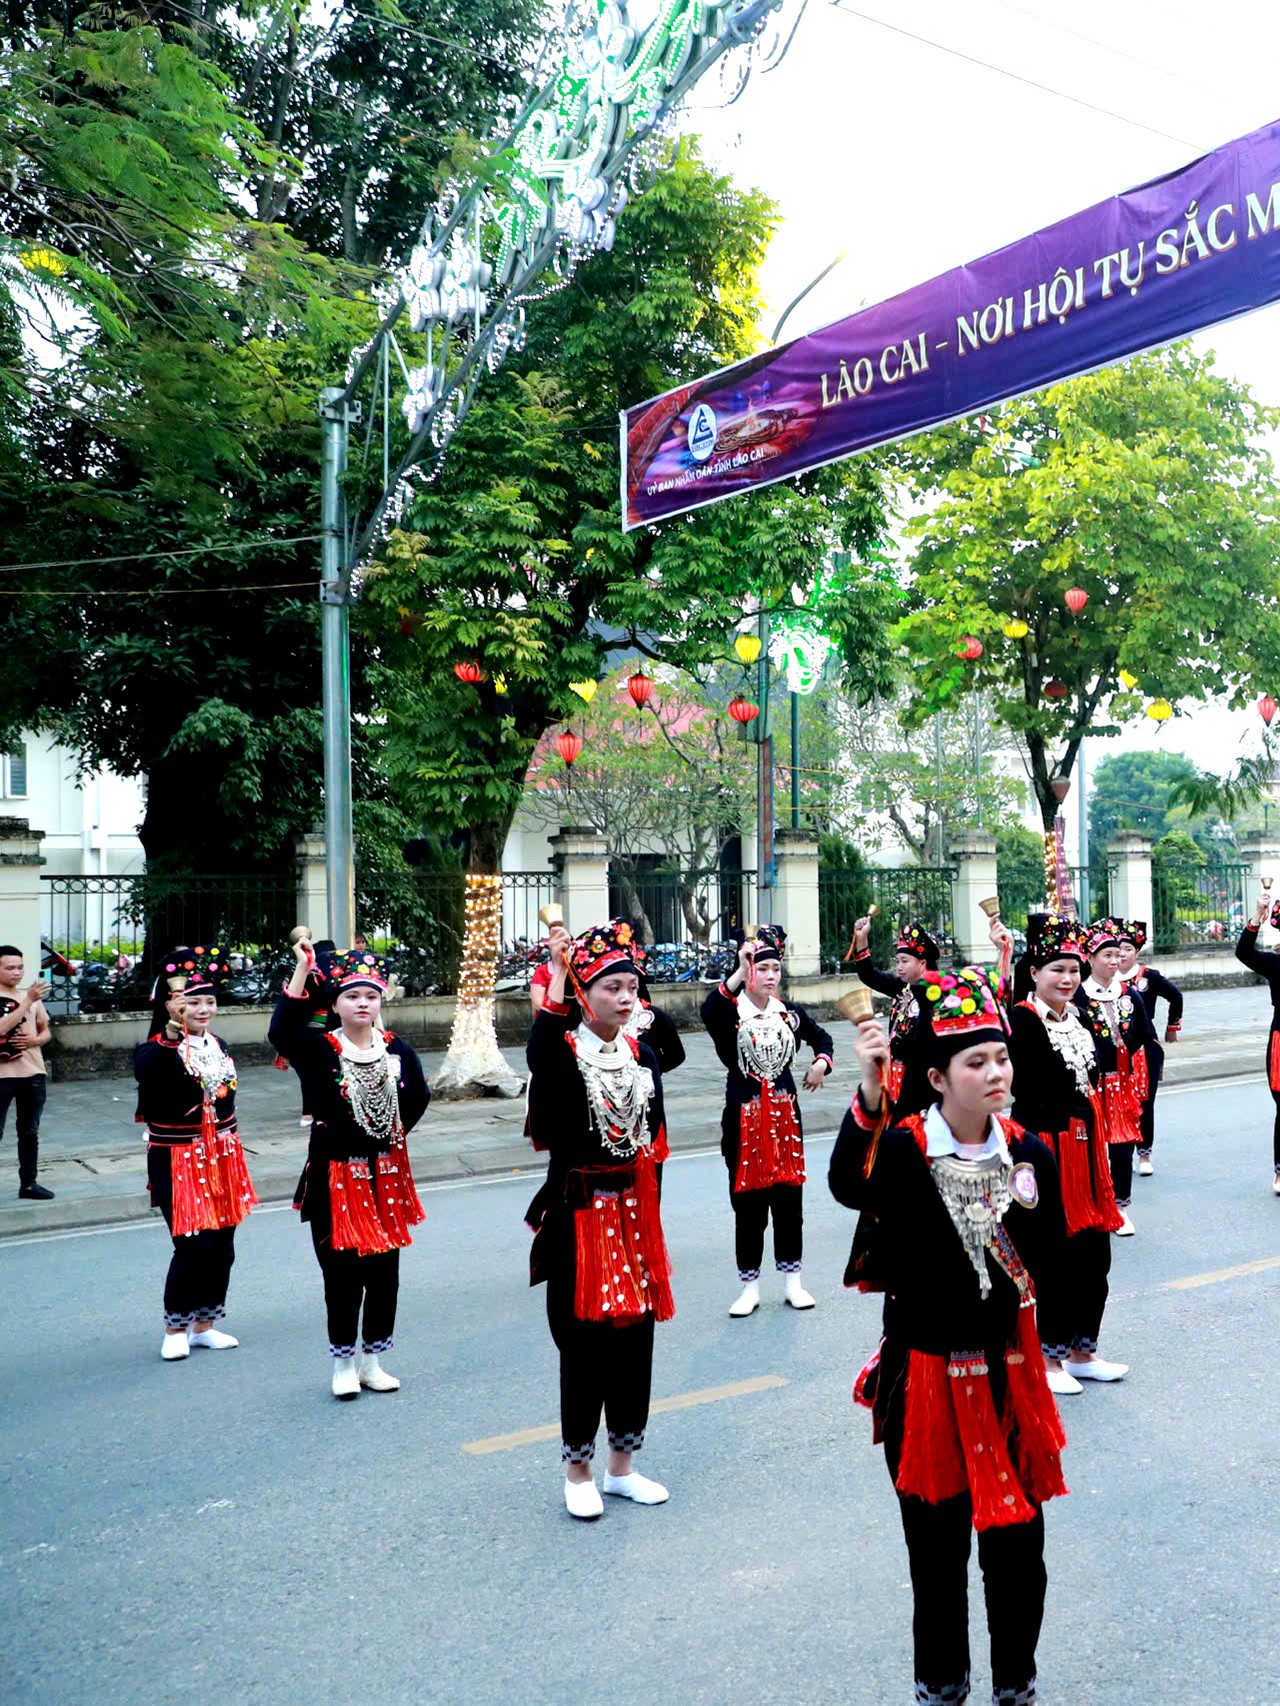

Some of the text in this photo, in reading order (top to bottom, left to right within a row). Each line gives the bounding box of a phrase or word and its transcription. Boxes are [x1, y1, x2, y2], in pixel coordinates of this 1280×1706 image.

[821, 359, 874, 409] LÀO
[879, 331, 930, 385] CAI
[956, 296, 1015, 356] NƠI
[1023, 266, 1087, 330] HỘI
[1093, 241, 1145, 298] TỤ
[1155, 200, 1238, 275] SẮC
[658, 480, 674, 492] BAN
[733, 452, 748, 467] LÀO
[750, 448, 764, 460] CAI
